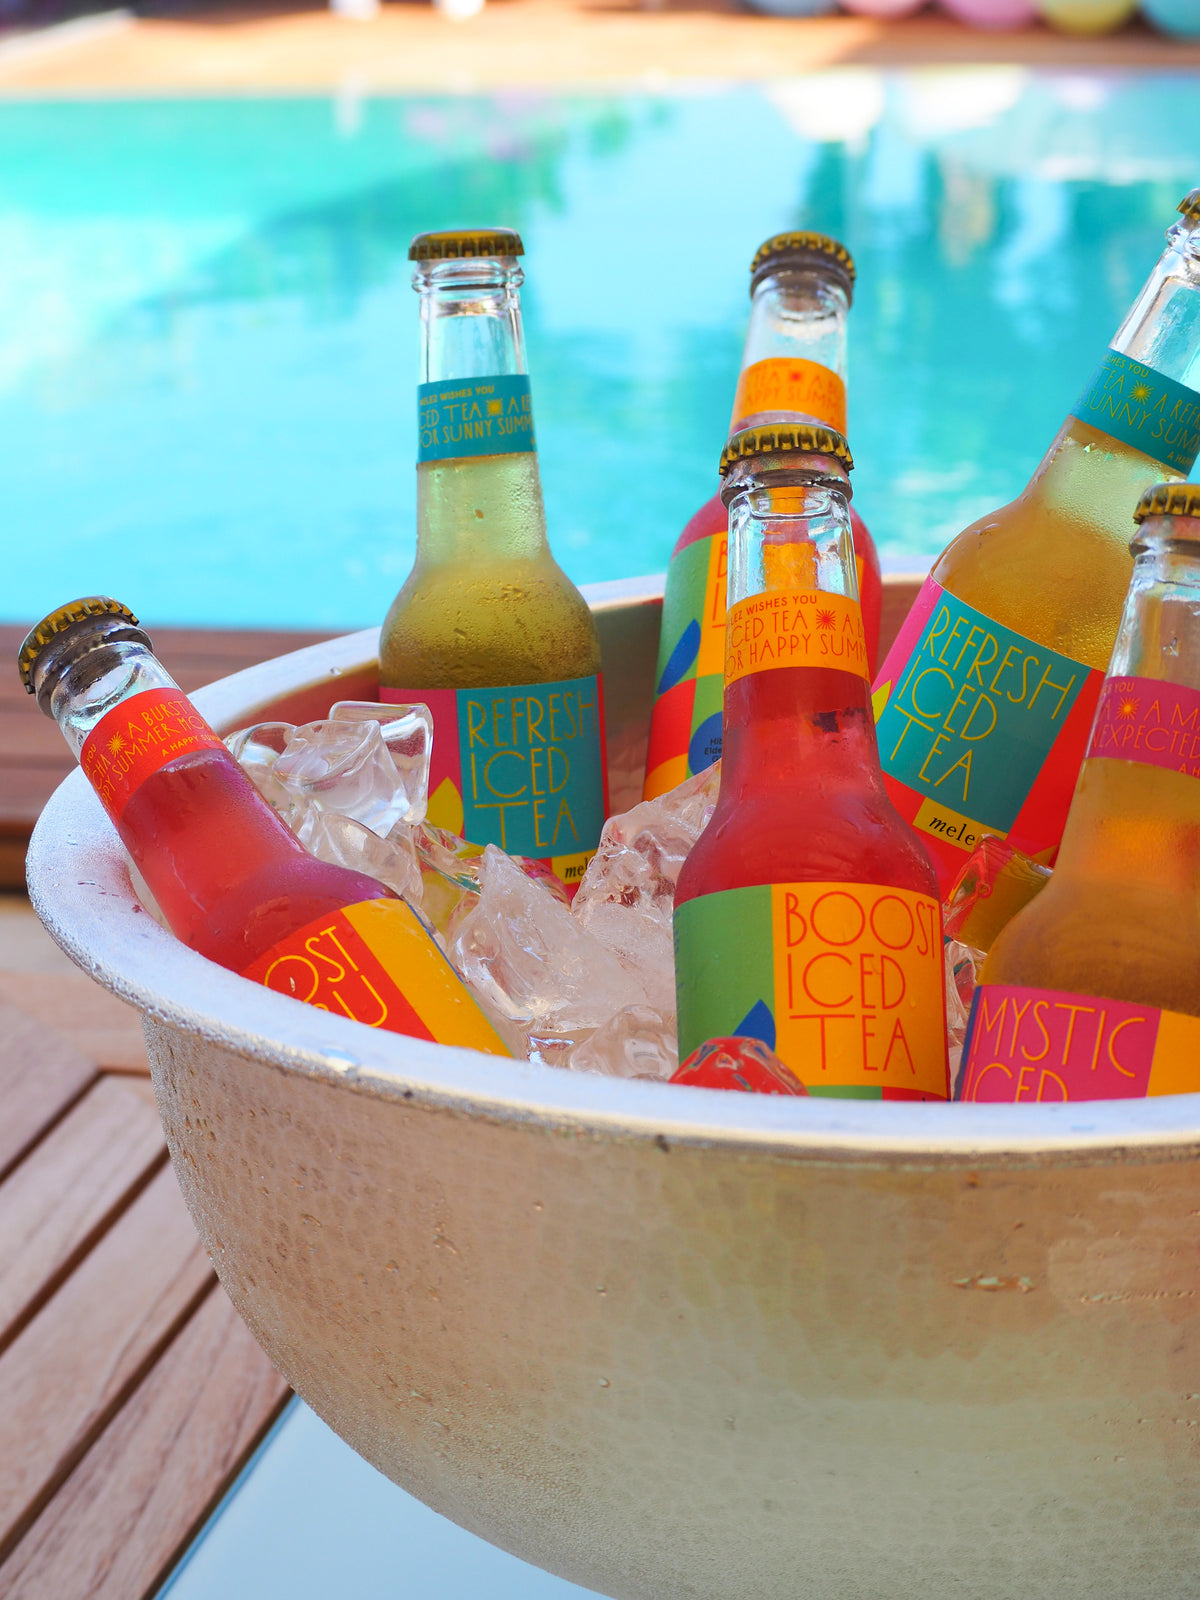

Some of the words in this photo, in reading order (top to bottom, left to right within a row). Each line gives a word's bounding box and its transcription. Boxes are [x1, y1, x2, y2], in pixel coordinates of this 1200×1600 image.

[440, 388, 473, 401] WISHES
[475, 385, 495, 395] YOU
[1095, 365, 1125, 395] TEA
[1153, 393, 1168, 413] A
[1128, 364, 1151, 378] YOU
[443, 402, 482, 422] TEA
[507, 396, 520, 414] A
[443, 419, 493, 443] SUNNY
[1083, 388, 1152, 430] SUNNY
[746, 597, 788, 616] WISHES
[792, 594, 818, 605] YOU
[772, 609, 808, 633] TEA
[842, 613, 854, 635] A
[750, 633, 812, 665] HAPPY
[923, 605, 1076, 720] REFRESH
[128, 721, 144, 739] A
[141, 700, 188, 727] BURST
[467, 687, 597, 748] REFRESH
[898, 654, 998, 741] ICED
[1143, 700, 1161, 723] A
[112, 722, 181, 781] SUMMER
[161, 748, 169, 757] A
[169, 735, 199, 751] HAPPY
[890, 704, 974, 802] TEA
[1179, 762, 1187, 774] A
[470, 746, 570, 800] ICED
[473, 796, 579, 850] TEA
[784, 890, 936, 960] BOOST
[787, 952, 907, 1010] ICED
[788, 1014, 916, 1075] TEA
[973, 997, 1146, 1079] MYSTIC
